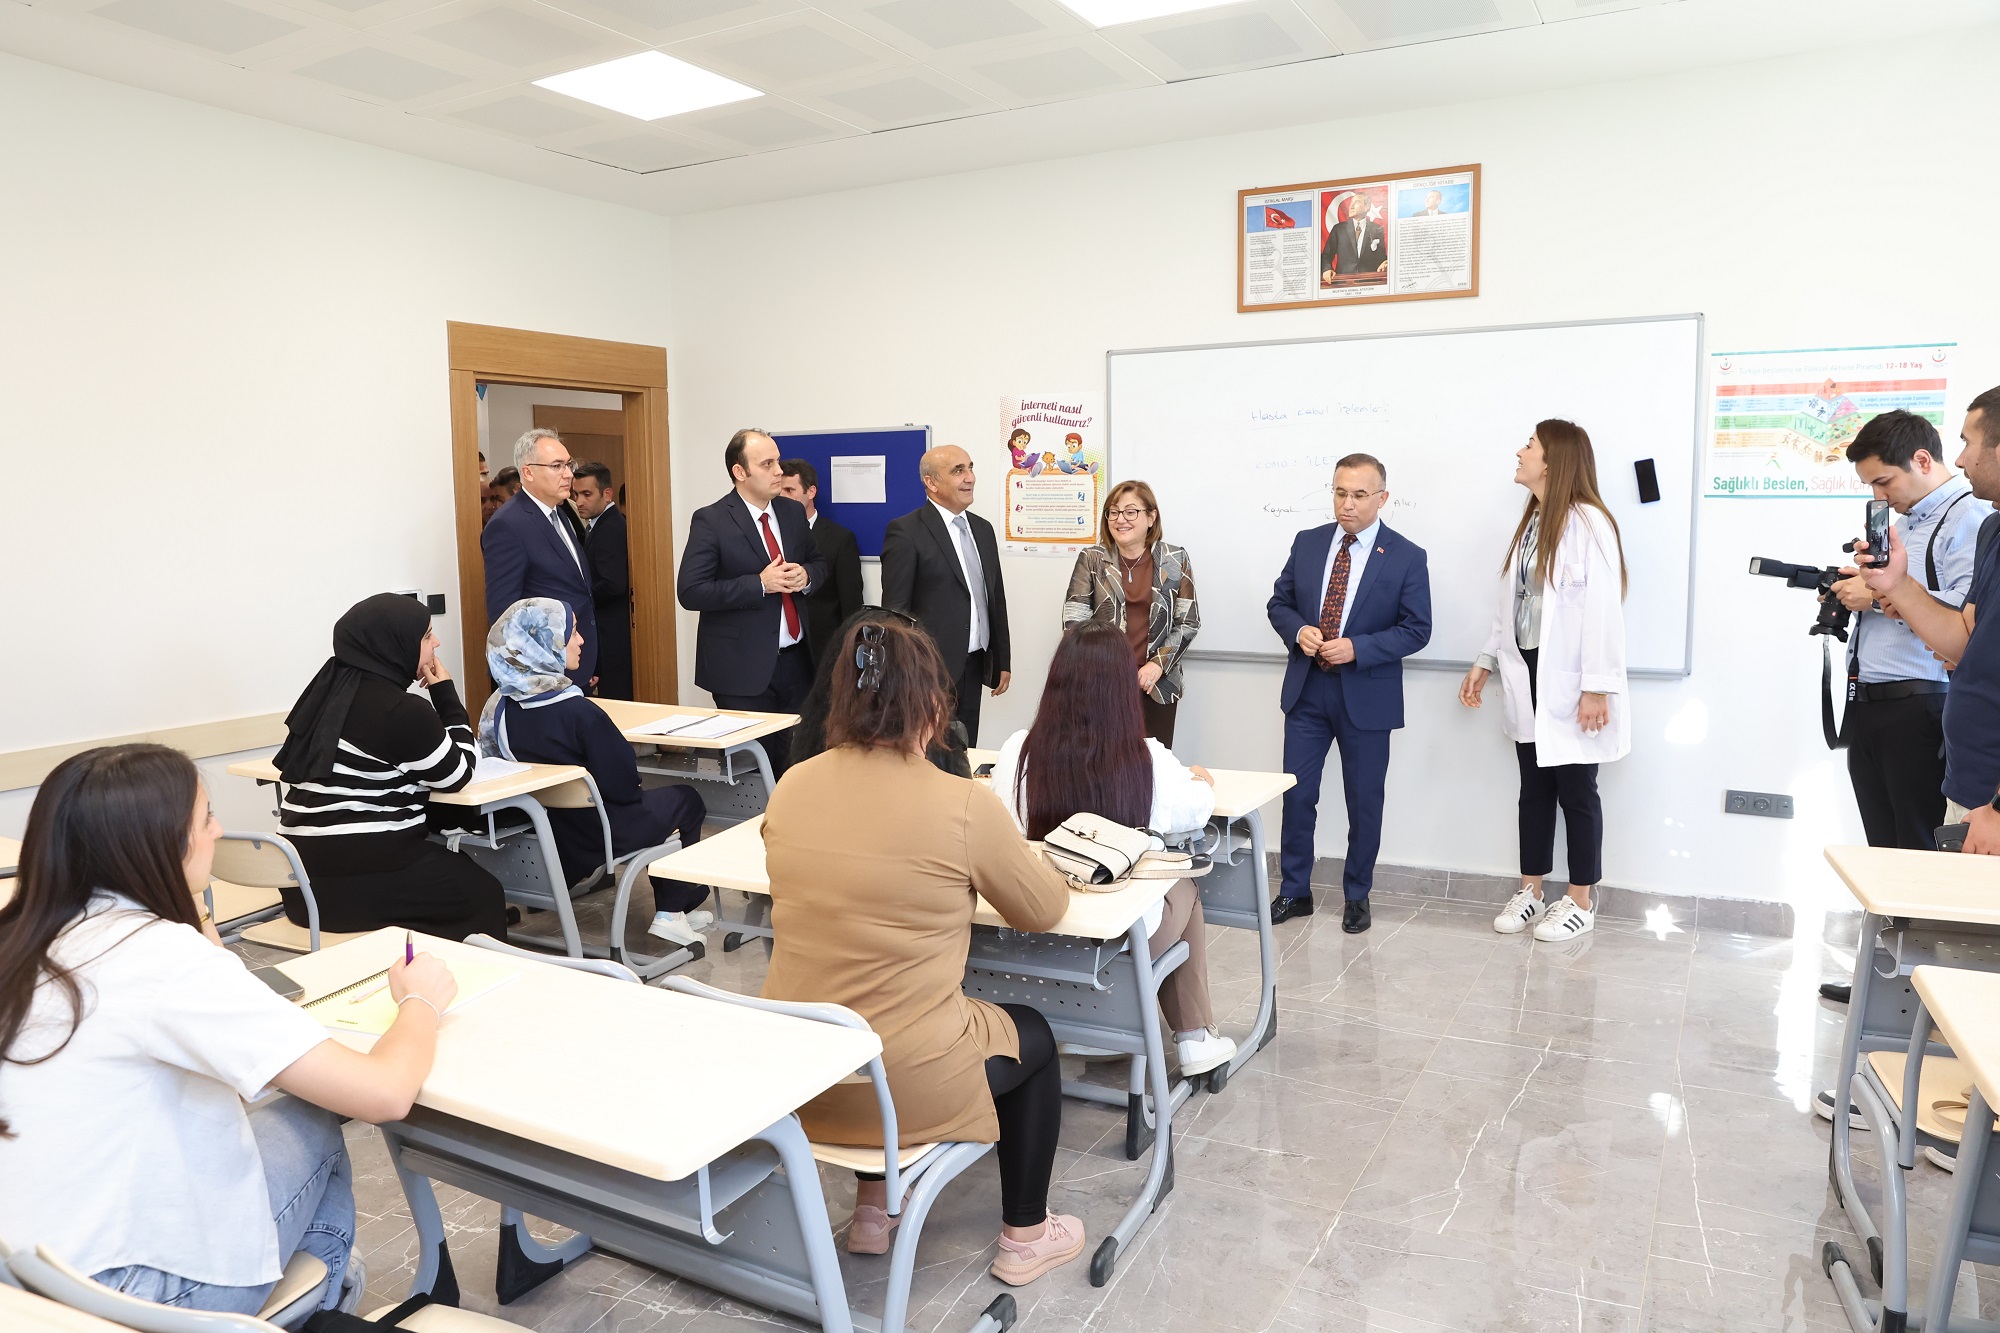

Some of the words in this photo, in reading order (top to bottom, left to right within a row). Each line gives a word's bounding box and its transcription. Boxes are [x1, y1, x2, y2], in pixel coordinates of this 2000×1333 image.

[1886, 362, 1908, 370] 12-18
[1910, 362, 1922, 370] Yaş
[1021, 399, 1058, 411] İnterneti
[1058, 404, 1082, 414] nasıl
[1012, 412, 1042, 428] güvenli
[1044, 413, 1092, 428] kullanırız?
[1713, 476, 1758, 494] Sağlıklı
[1763, 476, 1808, 492] Beslen,
[1811, 475, 1846, 494] Sağlık
